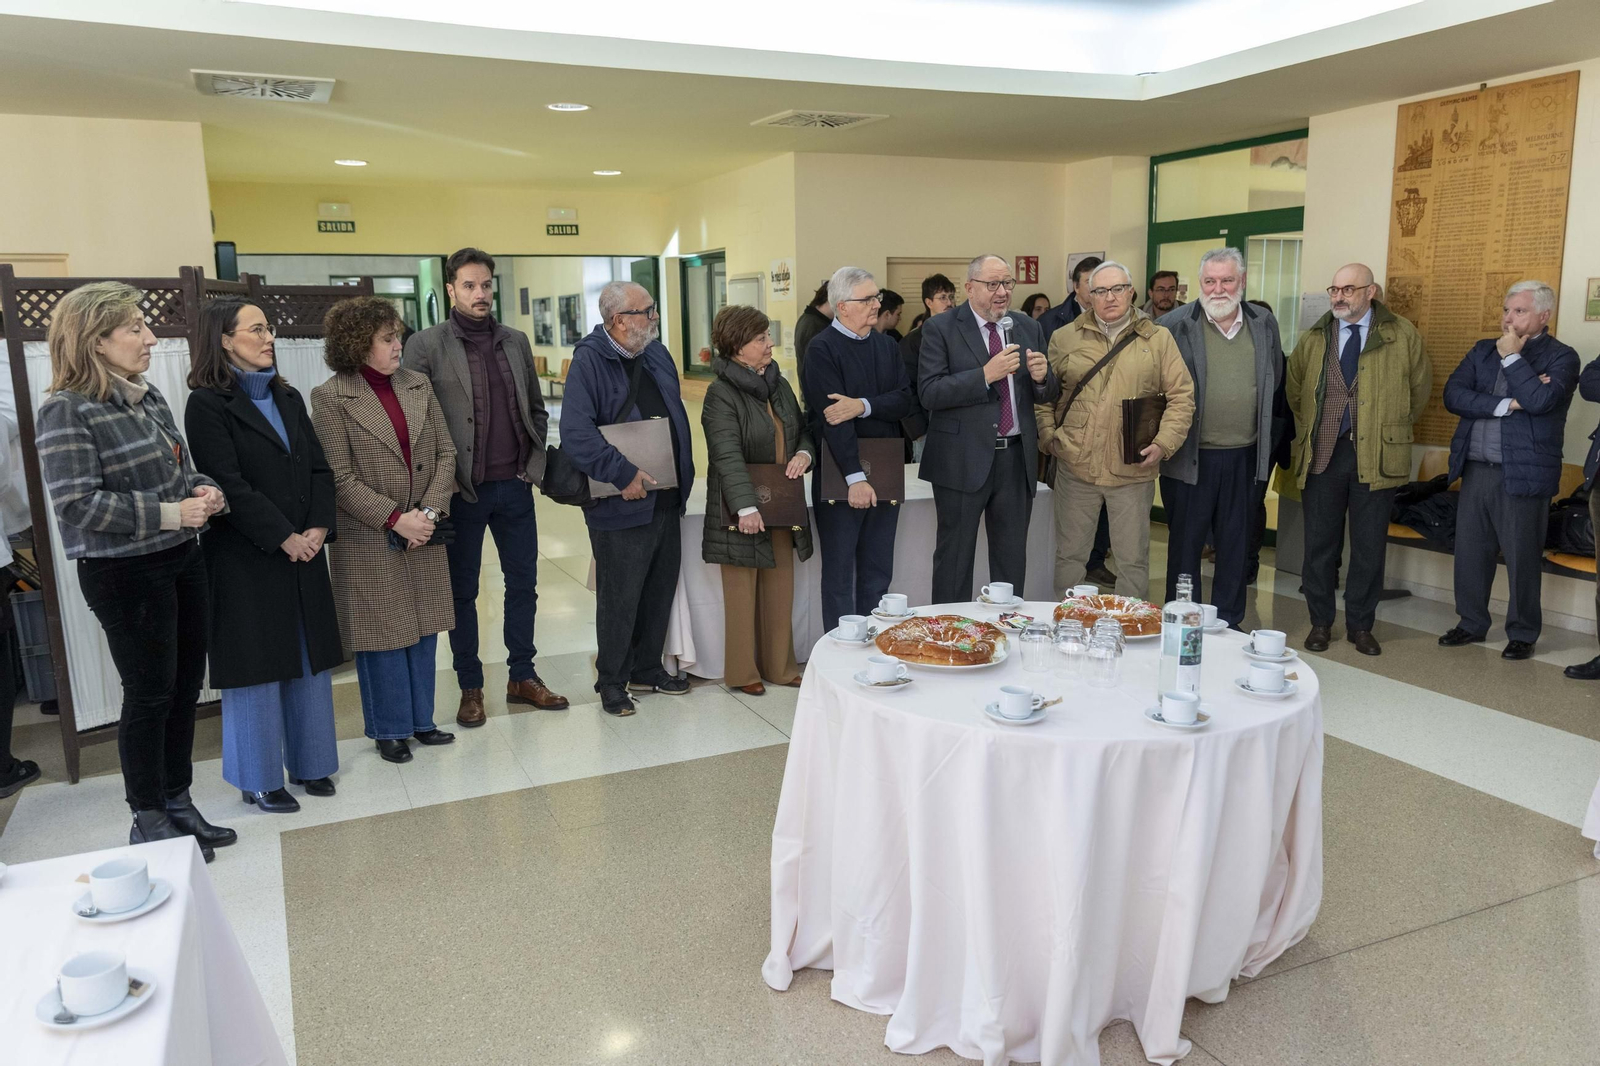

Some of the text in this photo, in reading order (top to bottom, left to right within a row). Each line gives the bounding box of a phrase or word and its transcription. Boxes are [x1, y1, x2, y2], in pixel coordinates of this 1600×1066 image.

[1525, 131, 1564, 142] MELBOURNE
[320, 222, 354, 232] SALIDA
[548, 225, 577, 234] SALIDA
